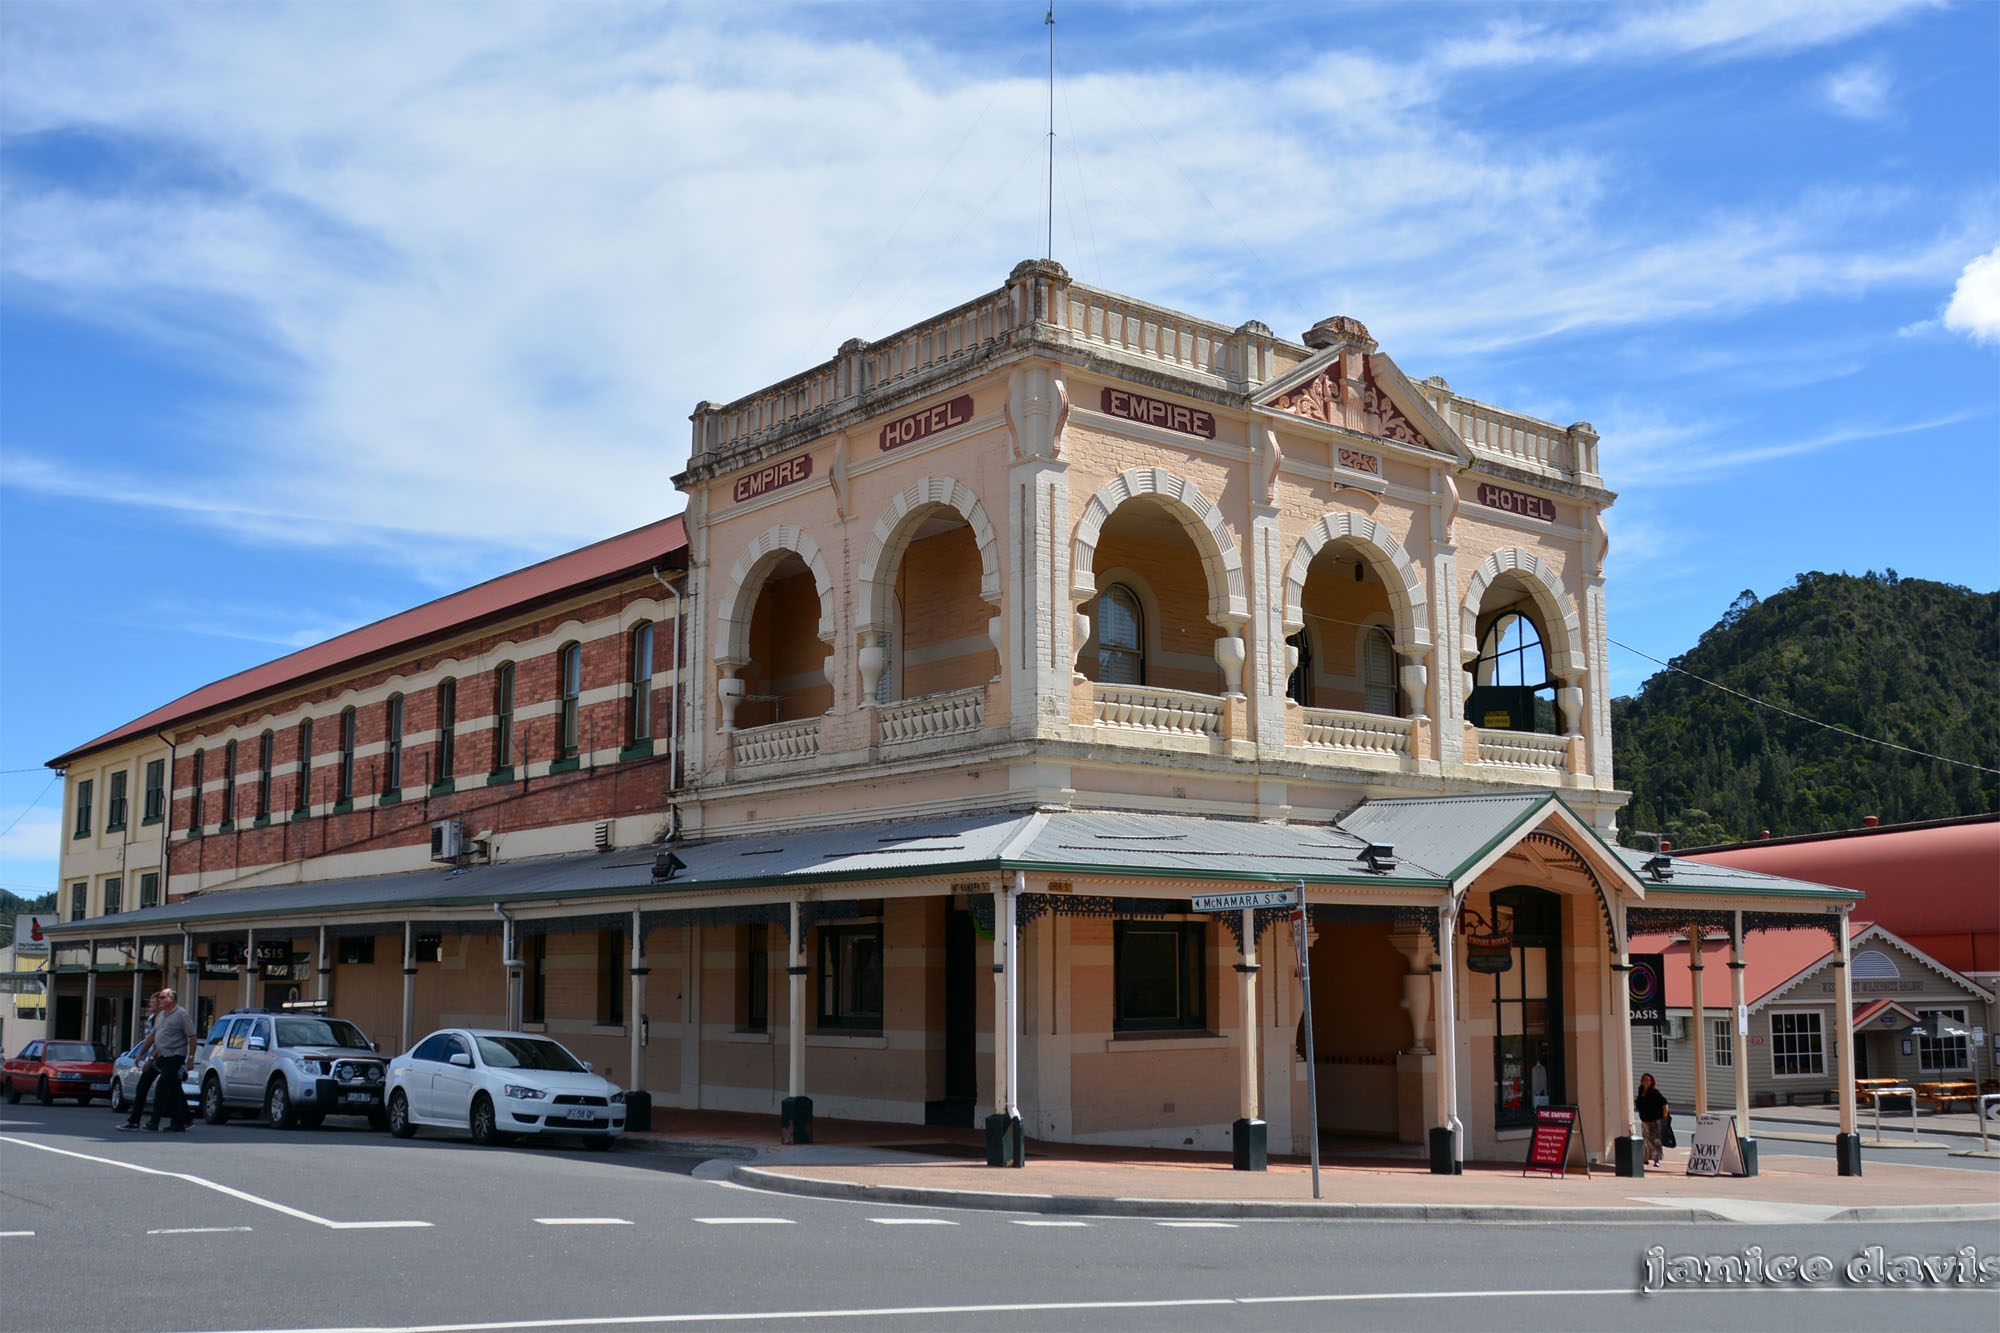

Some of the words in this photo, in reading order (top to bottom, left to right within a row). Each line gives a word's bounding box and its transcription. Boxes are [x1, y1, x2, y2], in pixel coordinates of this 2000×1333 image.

[885, 403, 963, 448] HOTEL
[1110, 390, 1210, 437] EMPIRE
[737, 457, 807, 500] EMPIRE
[1485, 486, 1552, 520] HOTEL
[1203, 894, 1259, 909] McNAMARA
[1688, 1157, 1720, 1171] OPEN
[1693, 1143, 1720, 1157] NOW
